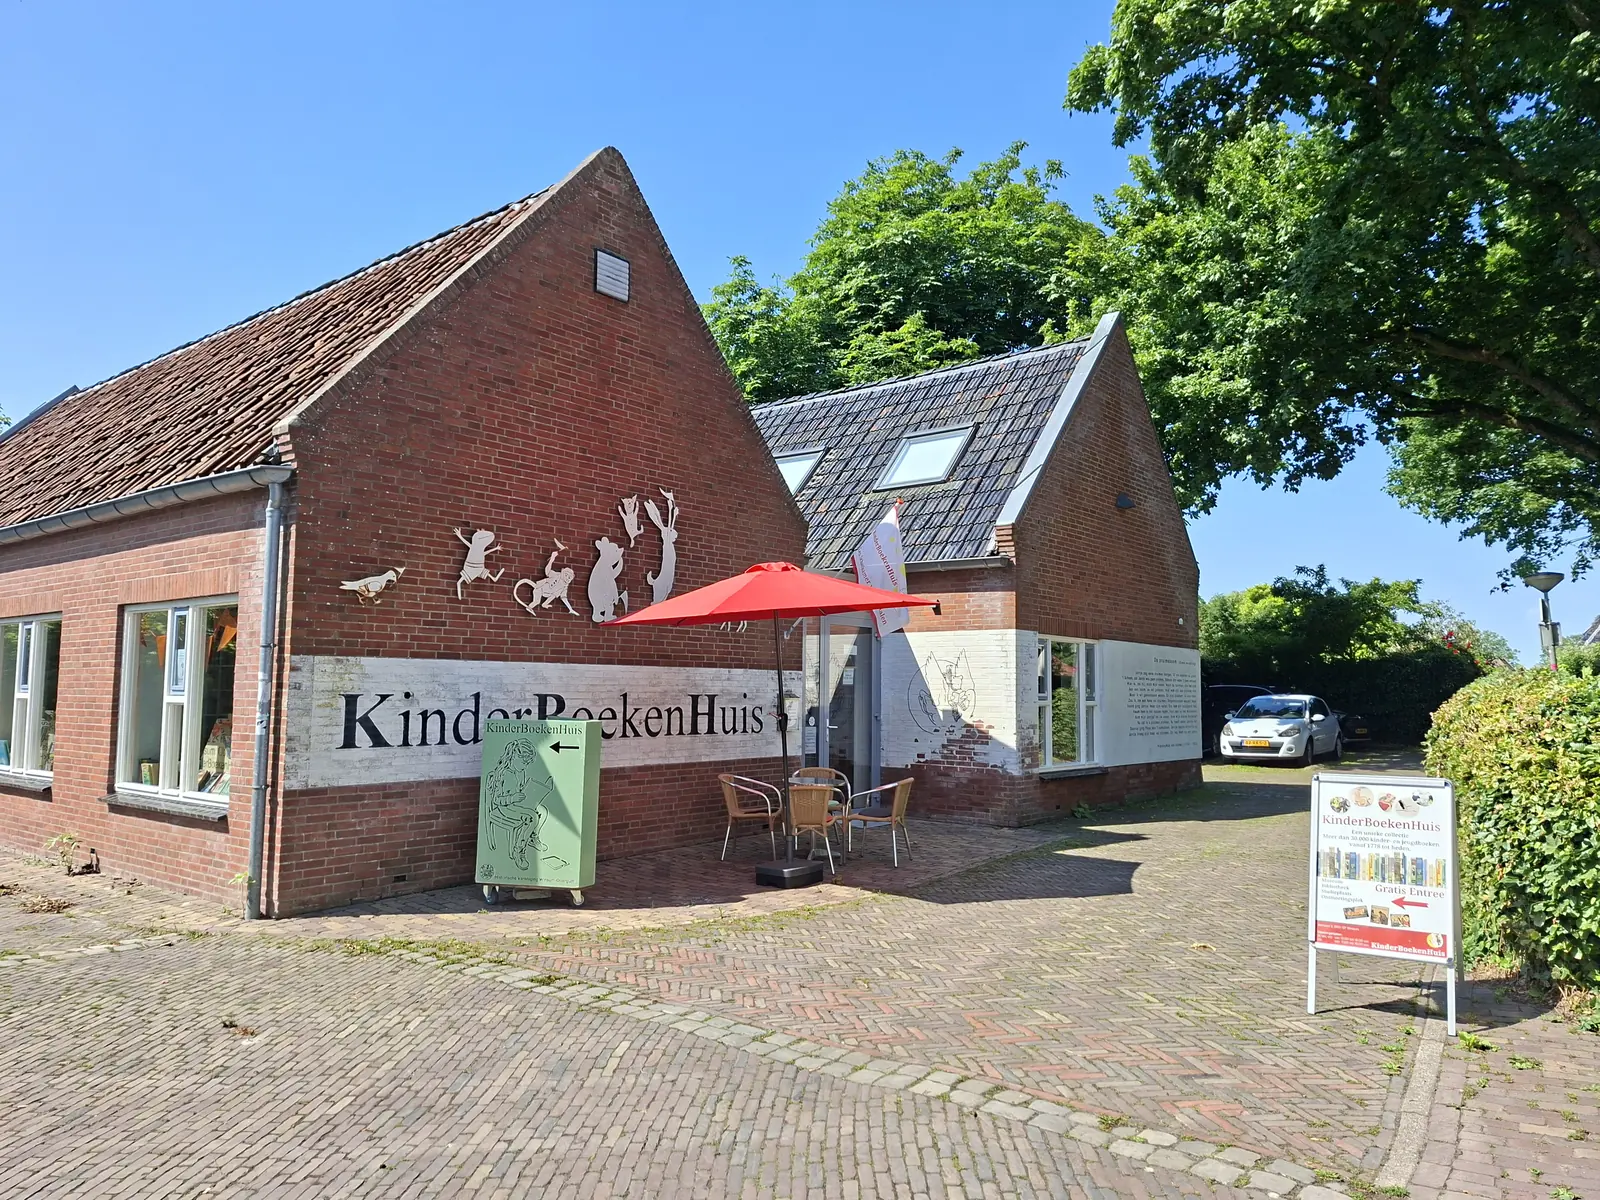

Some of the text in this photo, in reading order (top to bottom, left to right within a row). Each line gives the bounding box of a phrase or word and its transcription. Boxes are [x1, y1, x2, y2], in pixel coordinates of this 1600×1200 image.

[486, 722, 583, 735] KinderBoekenHuis
[1322, 814, 1441, 832] KinderBoekenHuis
[1375, 884, 1445, 899] Gratis Entree
[1371, 941, 1446, 957] KinderBoekenHuis
